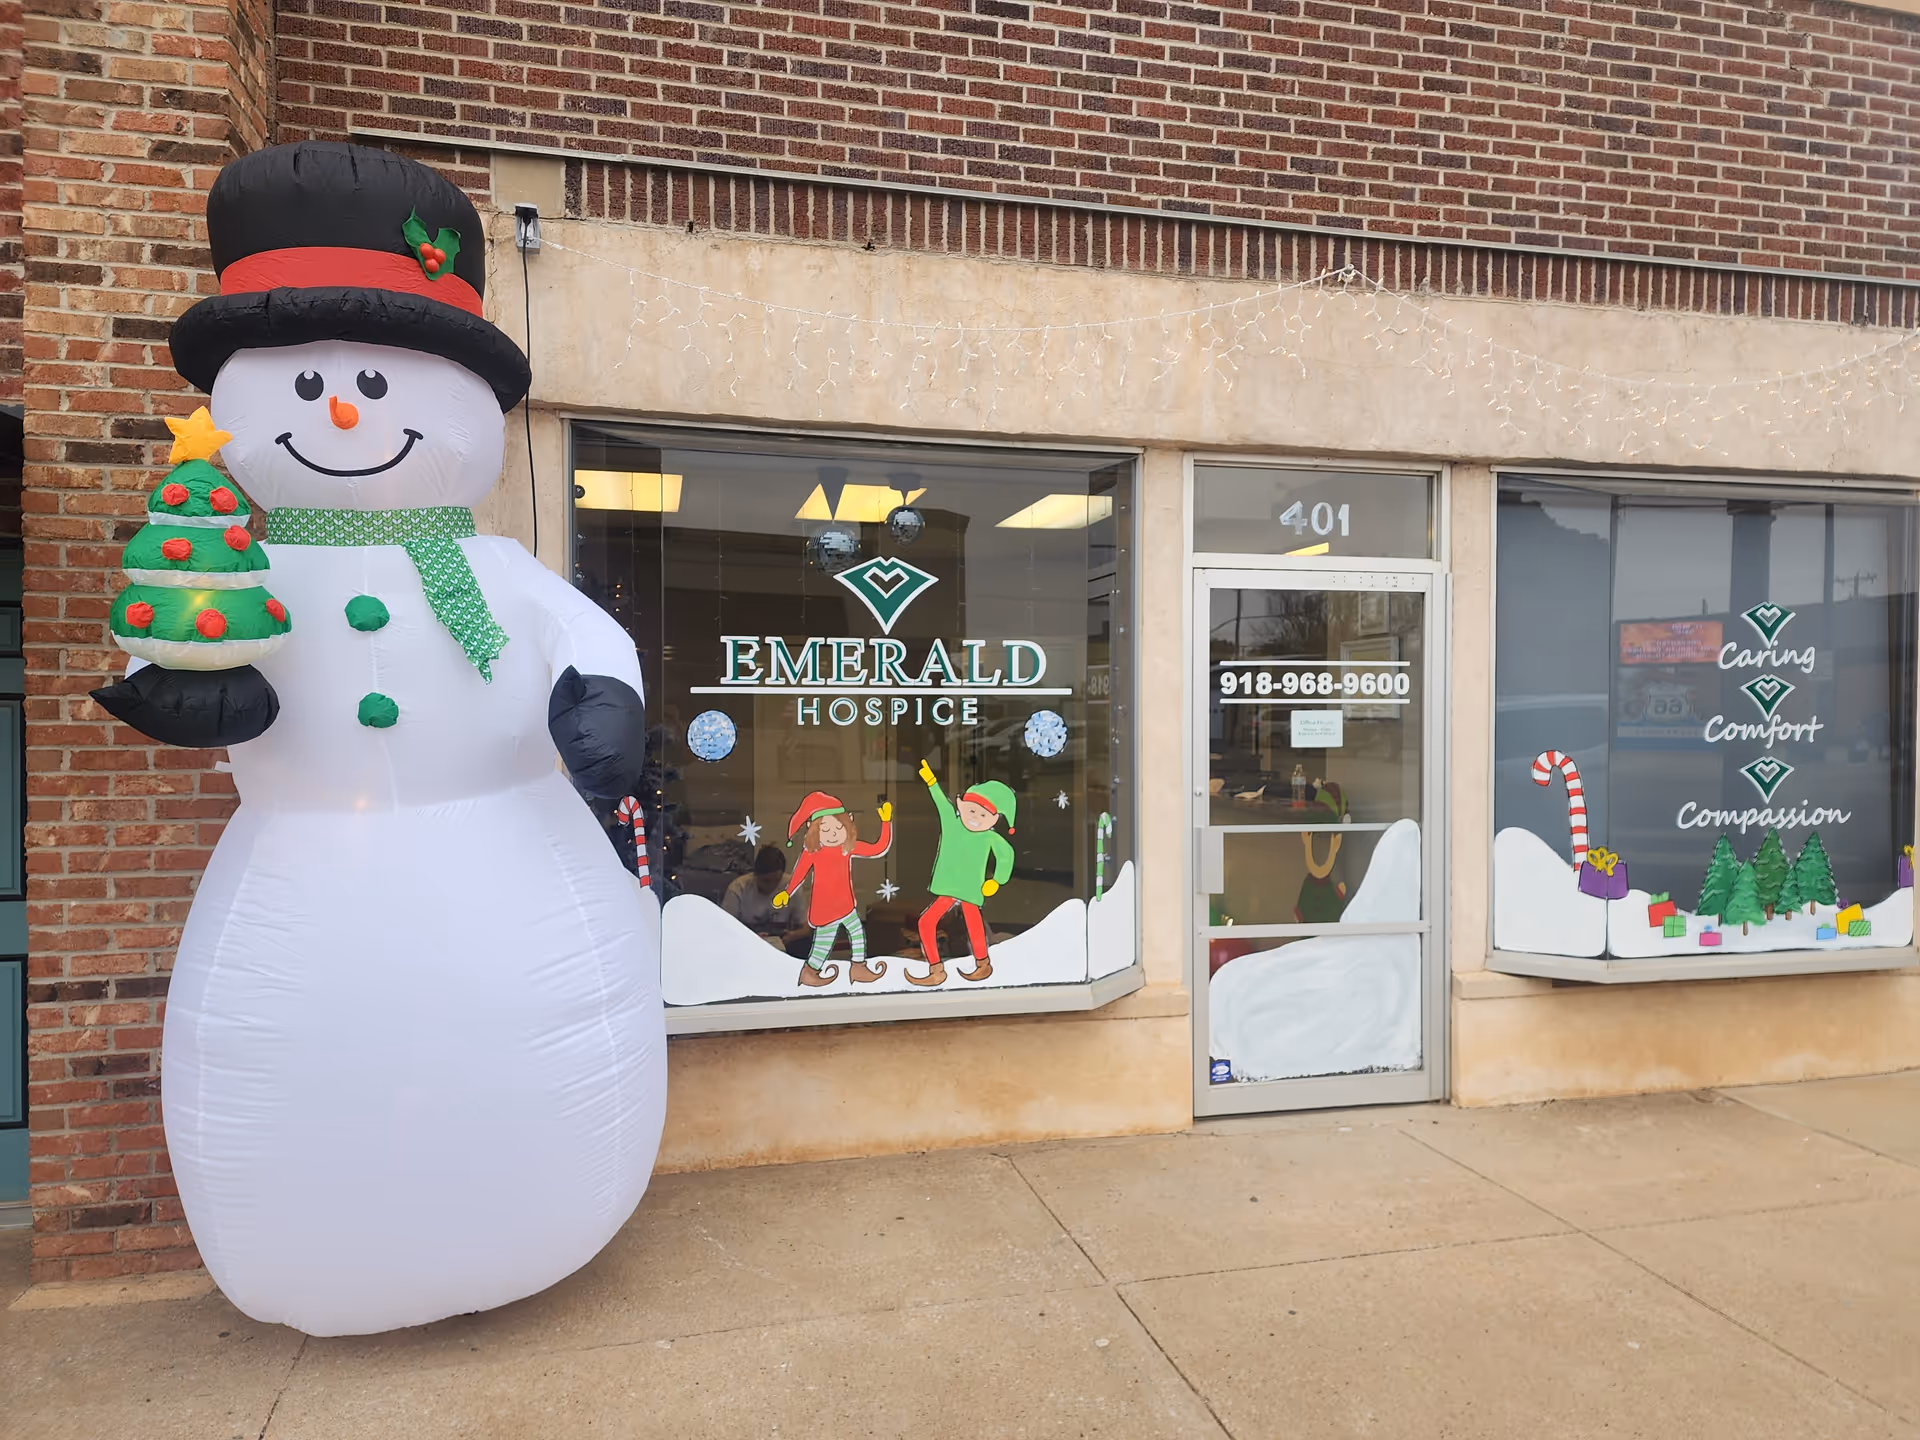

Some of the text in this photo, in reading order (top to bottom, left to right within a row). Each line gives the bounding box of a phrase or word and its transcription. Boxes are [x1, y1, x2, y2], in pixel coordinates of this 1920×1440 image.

[1278, 500, 1351, 537] 401
[719, 634, 1048, 687] EMERALD
[1717, 640, 1816, 674] Caring
[1220, 671, 1411, 696] 918-968-9600
[796, 696, 979, 727] HOSPICE
[1703, 713, 1825, 749] Comfort
[1676, 799, 1852, 835] Compassion
